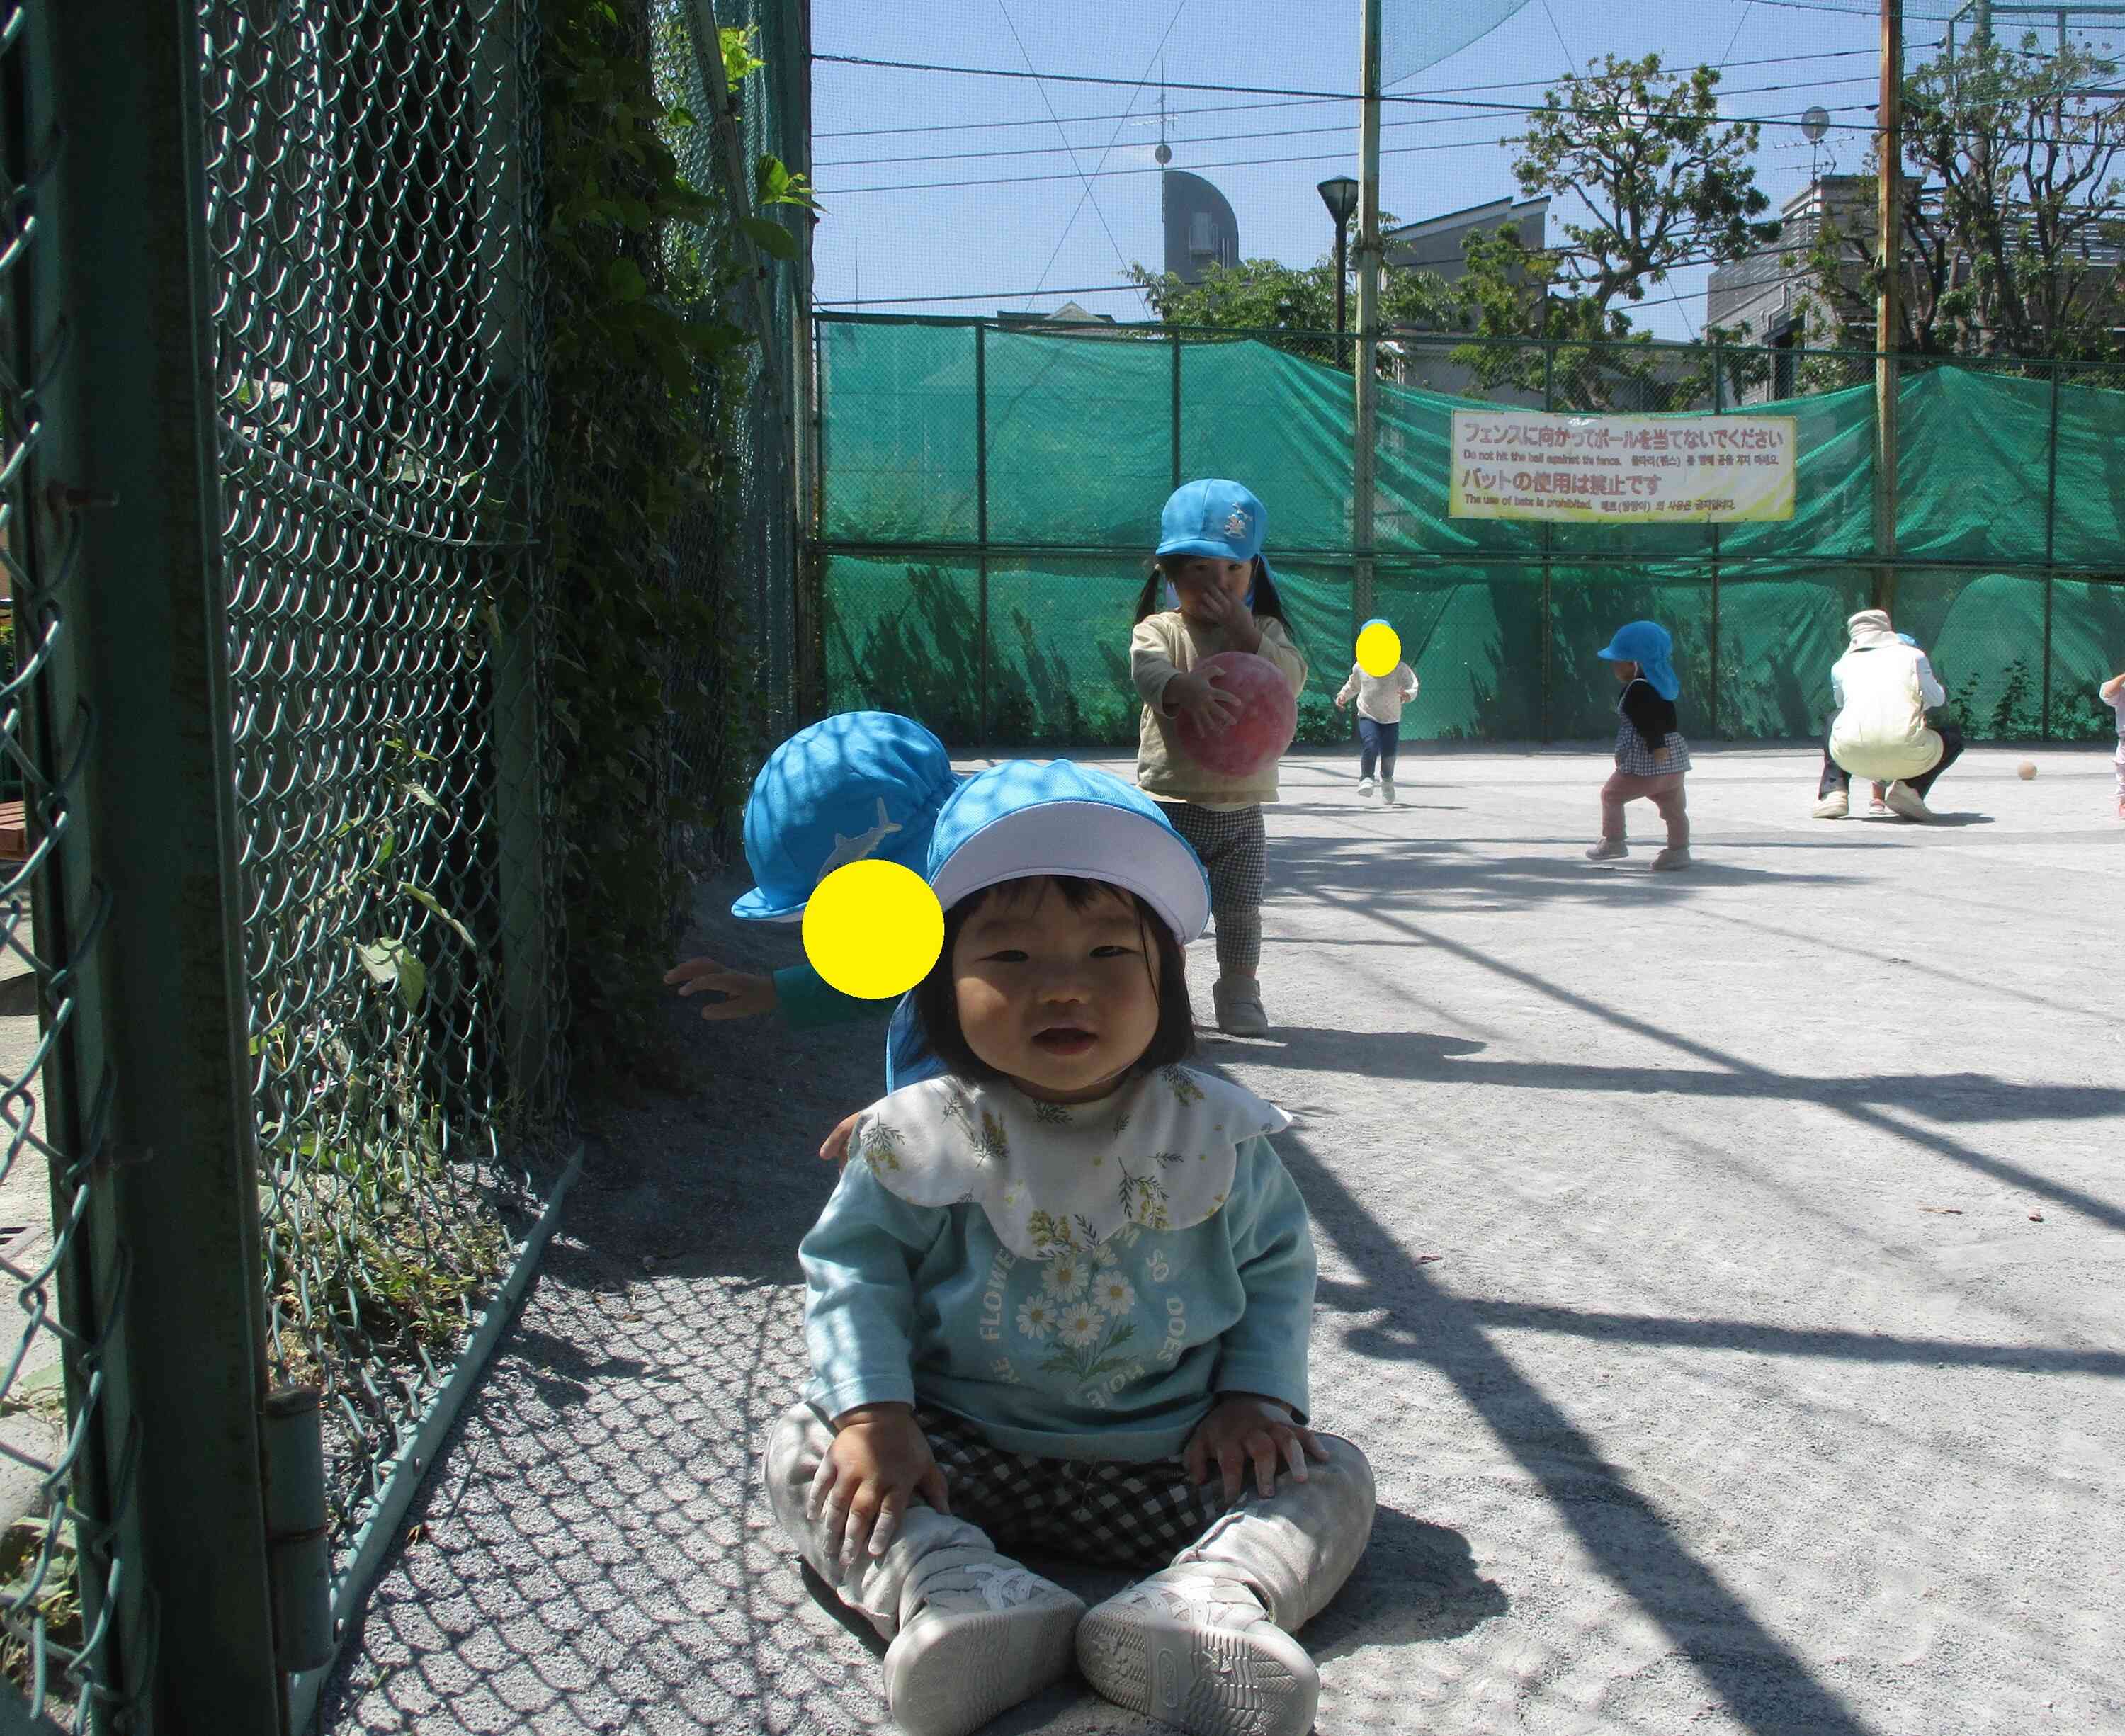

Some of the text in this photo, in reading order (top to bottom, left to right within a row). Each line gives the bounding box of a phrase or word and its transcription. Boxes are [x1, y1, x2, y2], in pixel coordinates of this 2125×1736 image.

[1463, 423, 1784, 450] フェンスに向かってボールを当てないでください
[1463, 449, 1476, 460] Do
[1478, 451, 1495, 461] not
[1496, 450, 1508, 461] hit
[1511, 452, 1526, 462] the
[1462, 467, 1662, 496] バットの使用は禁止です
[1465, 494, 1481, 504] The
[1502, 496, 1513, 505] of
[1536, 497, 1544, 507] is
[980, 1247, 1016, 1341] FLOWE
